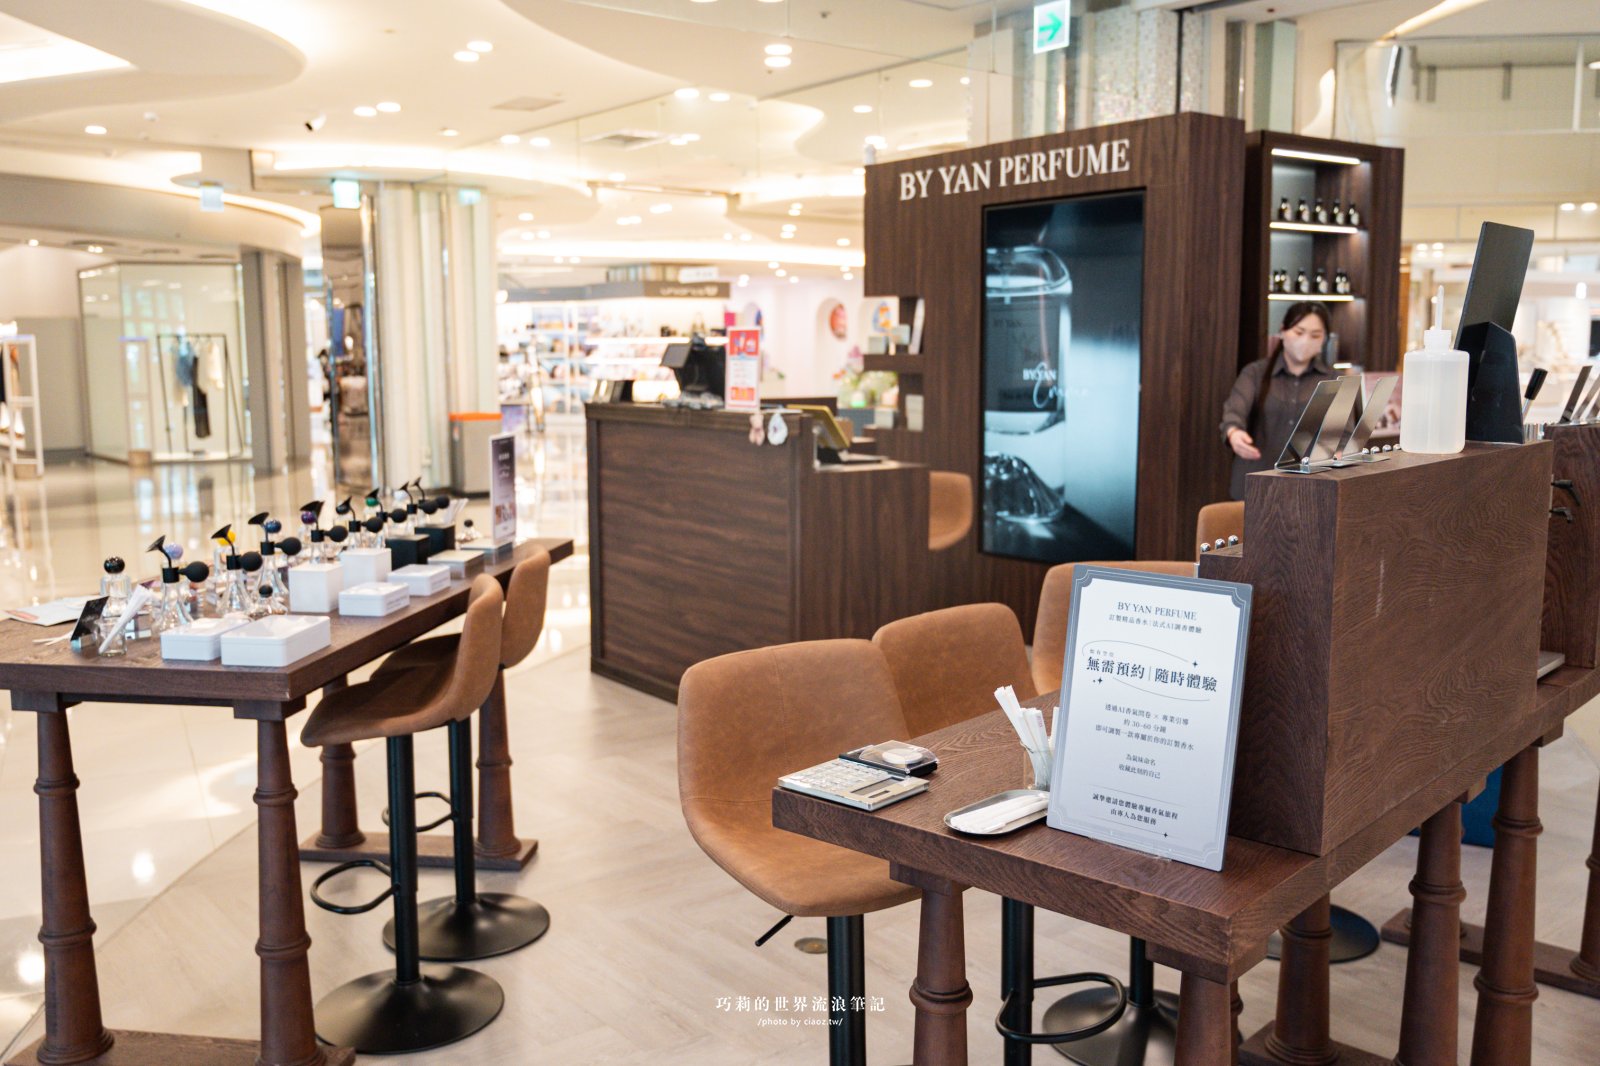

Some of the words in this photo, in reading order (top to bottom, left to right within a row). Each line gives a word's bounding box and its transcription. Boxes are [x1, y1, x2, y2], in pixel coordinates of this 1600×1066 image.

[899, 169, 933, 201] BY
[938, 160, 992, 195] YAN
[999, 138, 1130, 188] PERFUME
[1117, 601, 1131, 611] BY
[1133, 603, 1152, 614] YAN
[1155, 606, 1197, 621] PERFUME
[1110, 808, 1157, 826] 由專人為您服務
